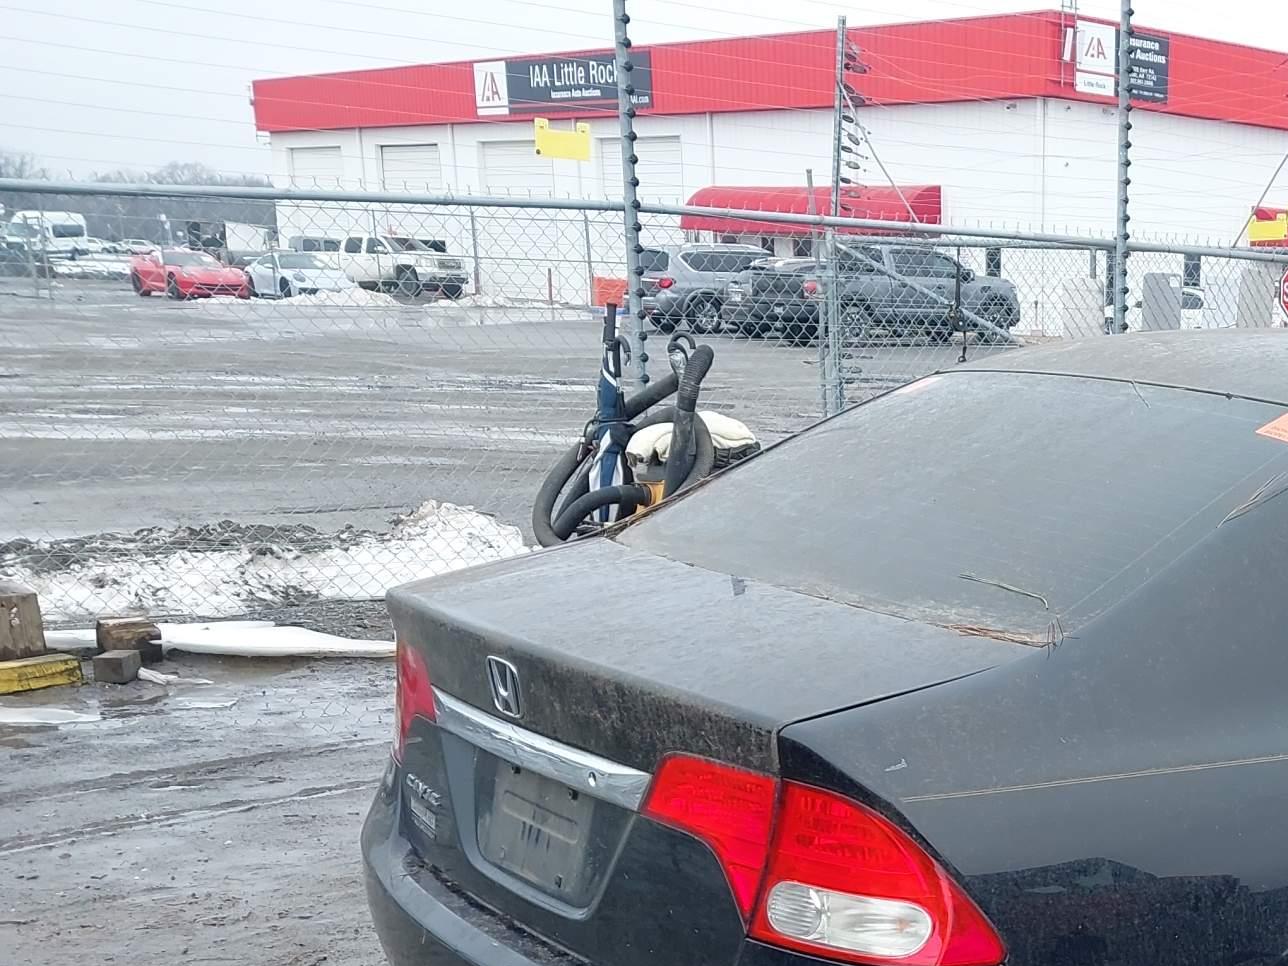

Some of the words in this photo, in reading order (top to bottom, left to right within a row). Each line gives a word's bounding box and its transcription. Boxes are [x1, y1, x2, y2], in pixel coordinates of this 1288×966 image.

[1135, 48, 1167, 64] Auctions
[529, 62, 550, 88] IAA
[553, 61, 586, 86] Little
